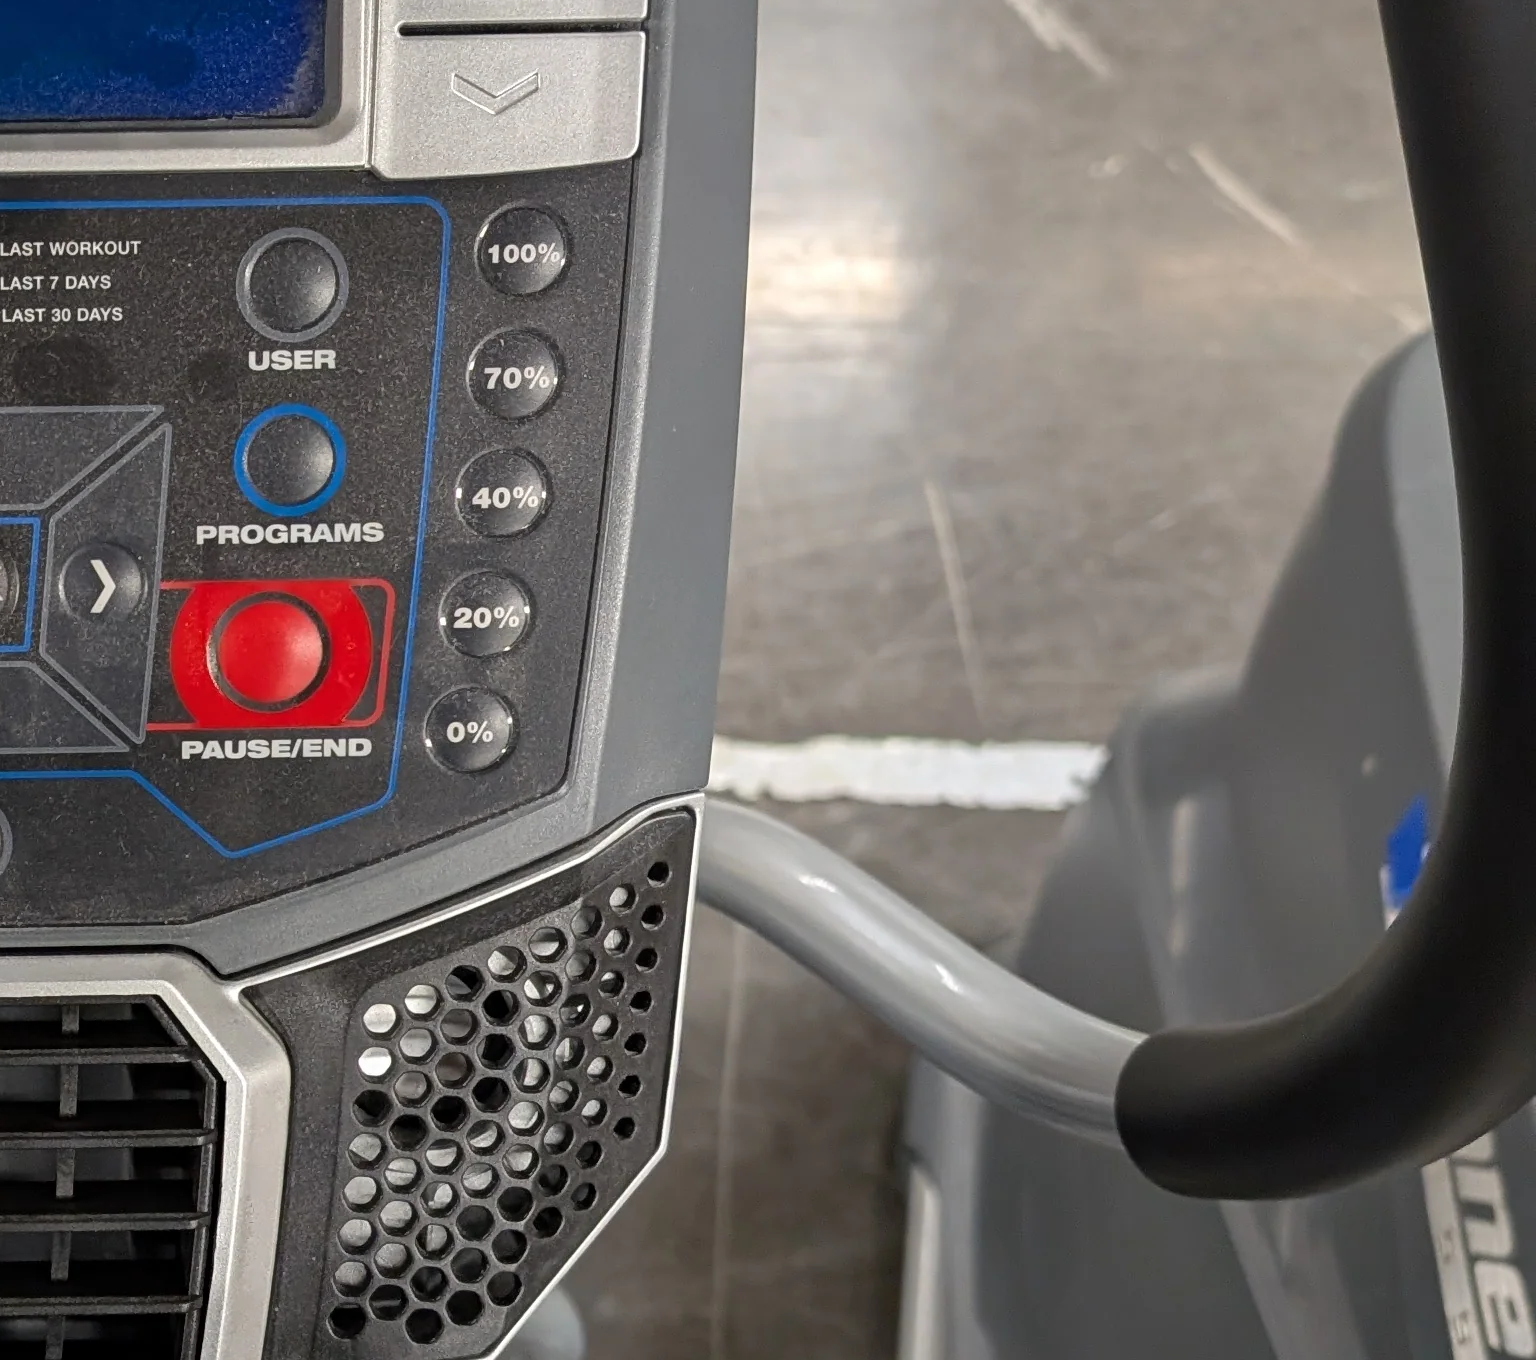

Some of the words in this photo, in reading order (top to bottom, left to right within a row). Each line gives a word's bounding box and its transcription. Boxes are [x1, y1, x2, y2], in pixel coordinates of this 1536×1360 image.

[0, 241, 45, 257] LAST
[48, 240, 142, 256] WORKOUT
[487, 242, 561, 264] 100%
[0, 275, 45, 291] LAST
[49, 275, 60, 290] 7
[65, 274, 112, 290] DAYS
[1, 307, 47, 323] LAST
[51, 307, 72, 323] 30
[77, 306, 123, 322] DAYS
[248, 349, 337, 371] USER
[484, 366, 551, 390] 70%
[471, 485, 540, 509] 40%
[196, 521, 385, 545] PROGRAMS
[452, 607, 521, 630] 20%
[445, 720, 496, 744] 0%
[181, 737, 373, 760] PAUSE/END
